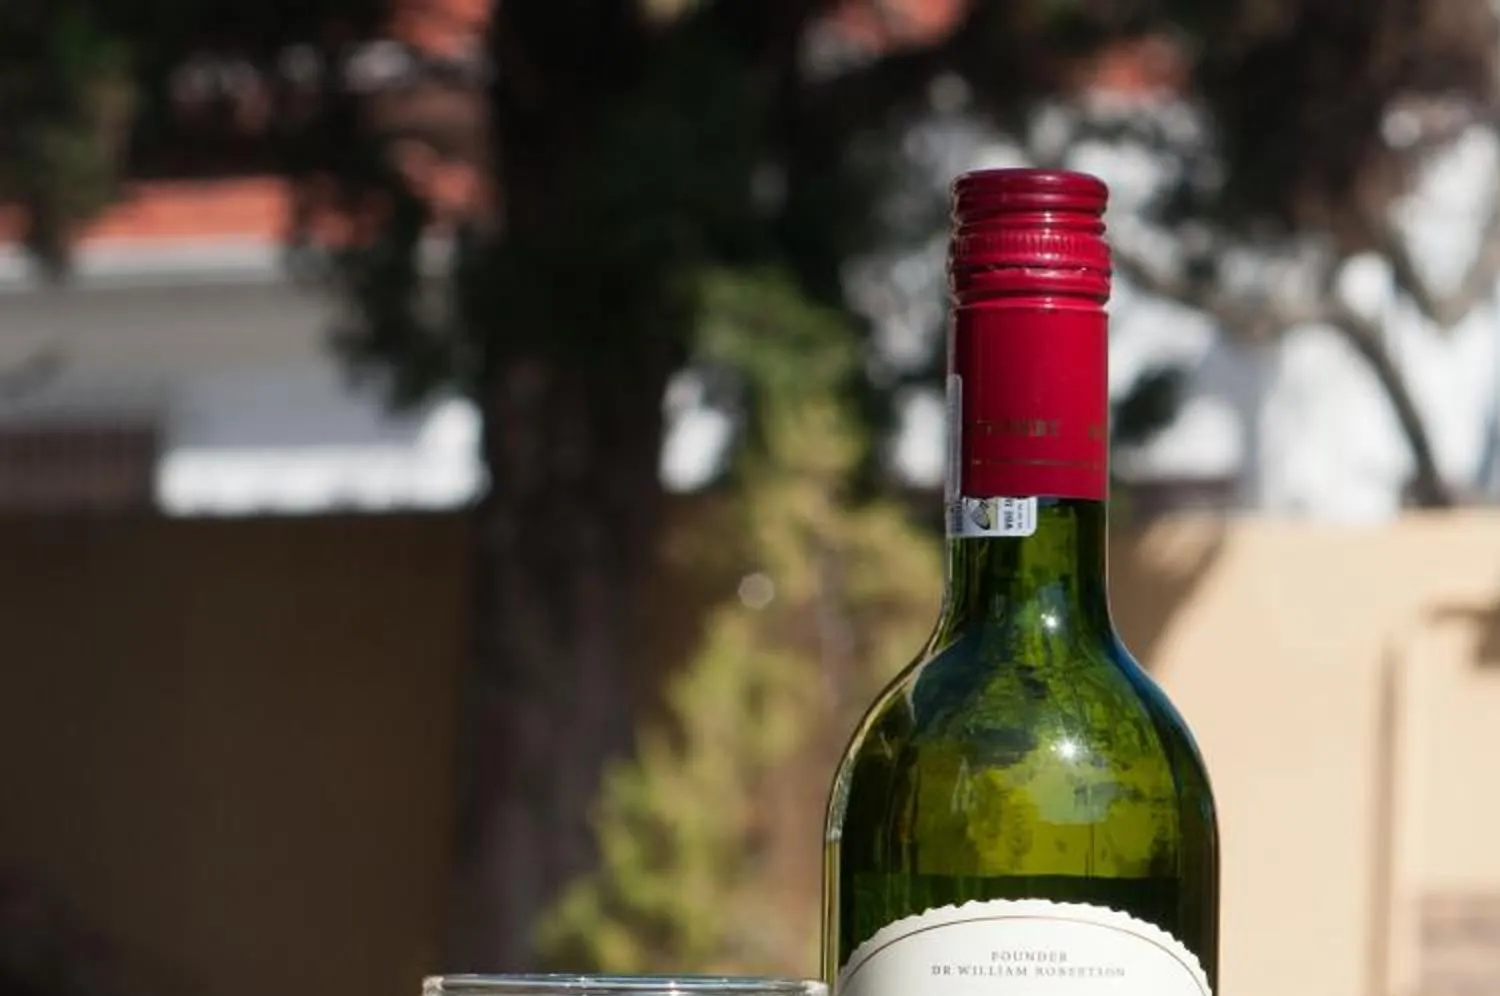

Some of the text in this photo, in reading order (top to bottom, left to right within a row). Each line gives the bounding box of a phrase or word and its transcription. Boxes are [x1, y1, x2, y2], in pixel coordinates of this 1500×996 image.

[991, 950, 1068, 963] FOUNDER
[931, 964, 951, 977] DR
[957, 964, 1028, 978] WILLIAM
